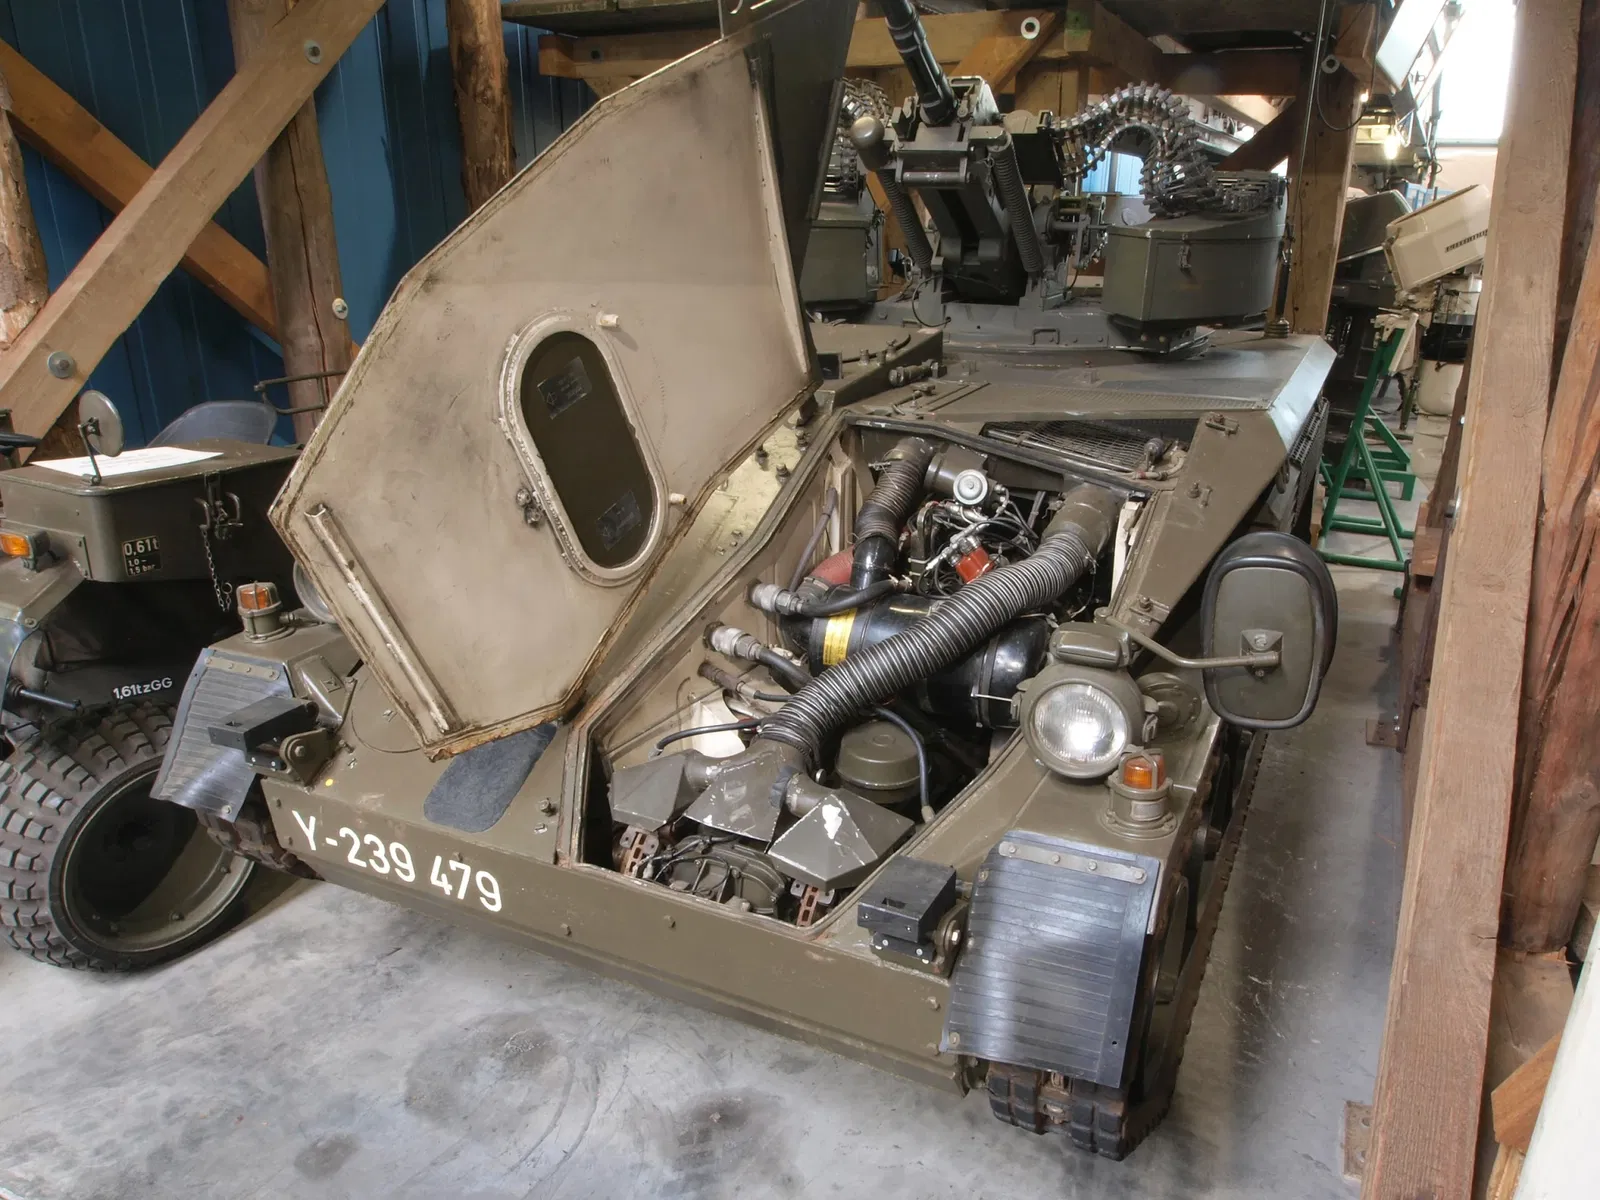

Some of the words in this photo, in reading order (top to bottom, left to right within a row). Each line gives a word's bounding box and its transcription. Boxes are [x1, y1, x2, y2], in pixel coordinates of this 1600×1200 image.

[124, 538, 159, 556] 0,61t
[291, 810, 416, 883] Y-239
[430, 855, 502, 913] 479
